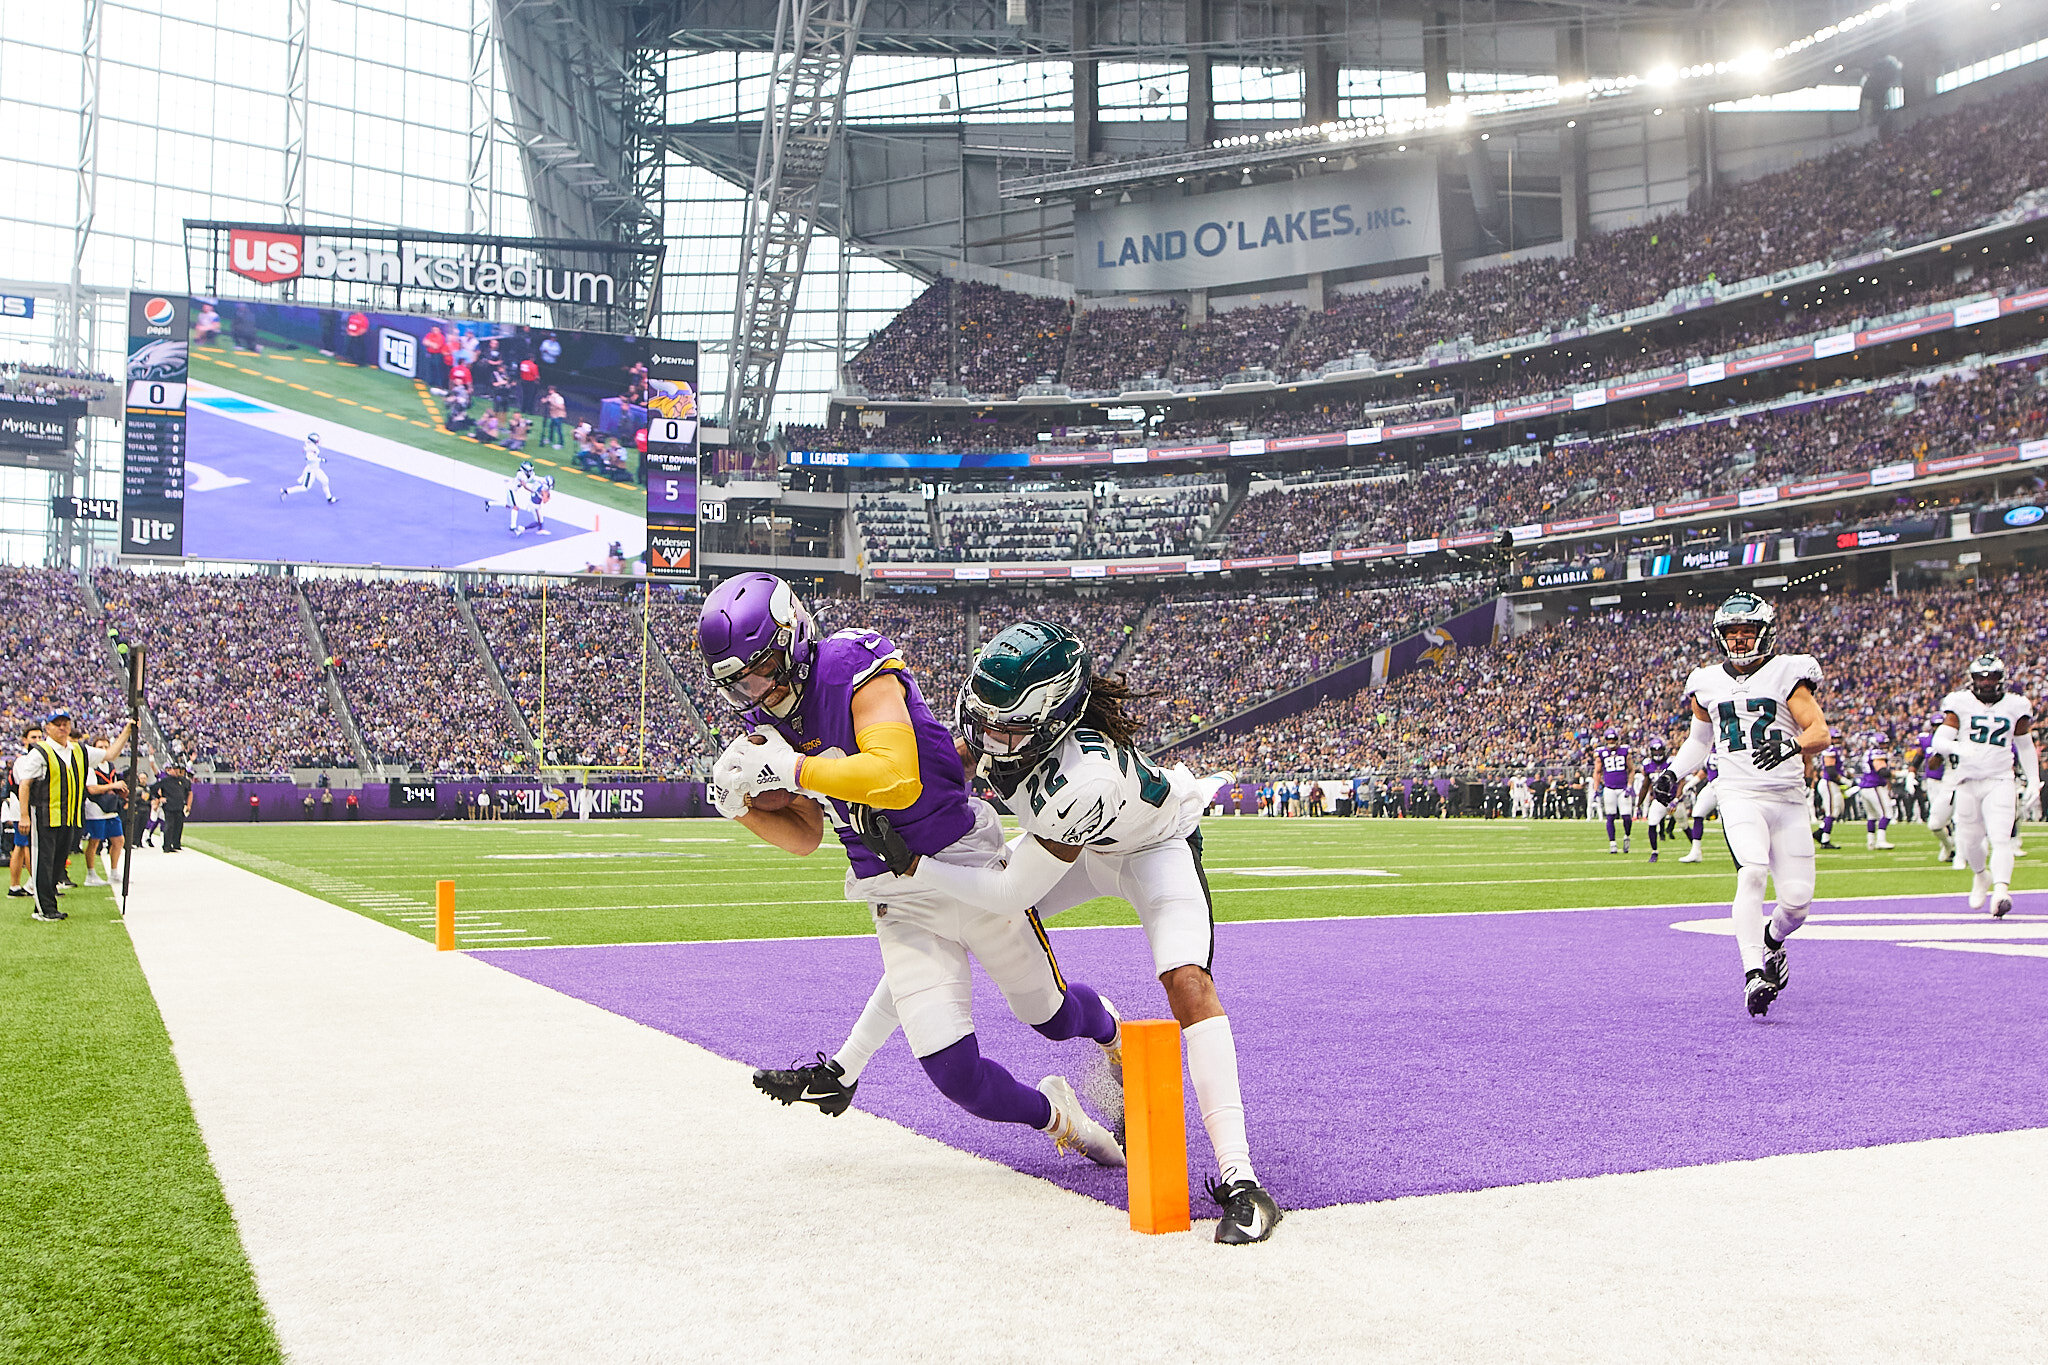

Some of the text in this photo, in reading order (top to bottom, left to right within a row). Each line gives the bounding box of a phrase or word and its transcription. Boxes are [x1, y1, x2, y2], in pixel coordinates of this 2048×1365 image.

[1097, 230, 1187, 268] LAND
[1367, 206, 1411, 232] INC.
[146, 326, 172, 336] pepsi
[383, 336, 414, 369] 40
[661, 356, 695, 366] PENTAIR
[150, 384, 165, 404] 0
[173, 423, 179, 432] 0
[666, 421, 678, 440] 0
[172, 434, 179, 443] 0
[172, 445, 179, 454] 0
[172, 456, 178, 466] 0
[647, 453, 697, 465] FIRST DOWNS
[809, 452, 849, 466] LEADERS
[662, 464, 682, 472] TODAY
[171, 478, 178, 488] 0
[665, 479, 679, 501] 5
[70, 497, 115, 519] 7:44
[702, 503, 724, 521] 40
[130, 517, 175, 545] Lite
[652, 536, 691, 548] Andersen
[1836, 531, 1859, 549] 3M
[1537, 570, 1588, 586] CAMBRIA
[1718, 697, 1783, 752] 42
[1969, 715, 2011, 748] 52
[756, 776, 781, 785] adidas
[1026, 757, 1069, 818] 22
[402, 786, 435, 802] 7:44
